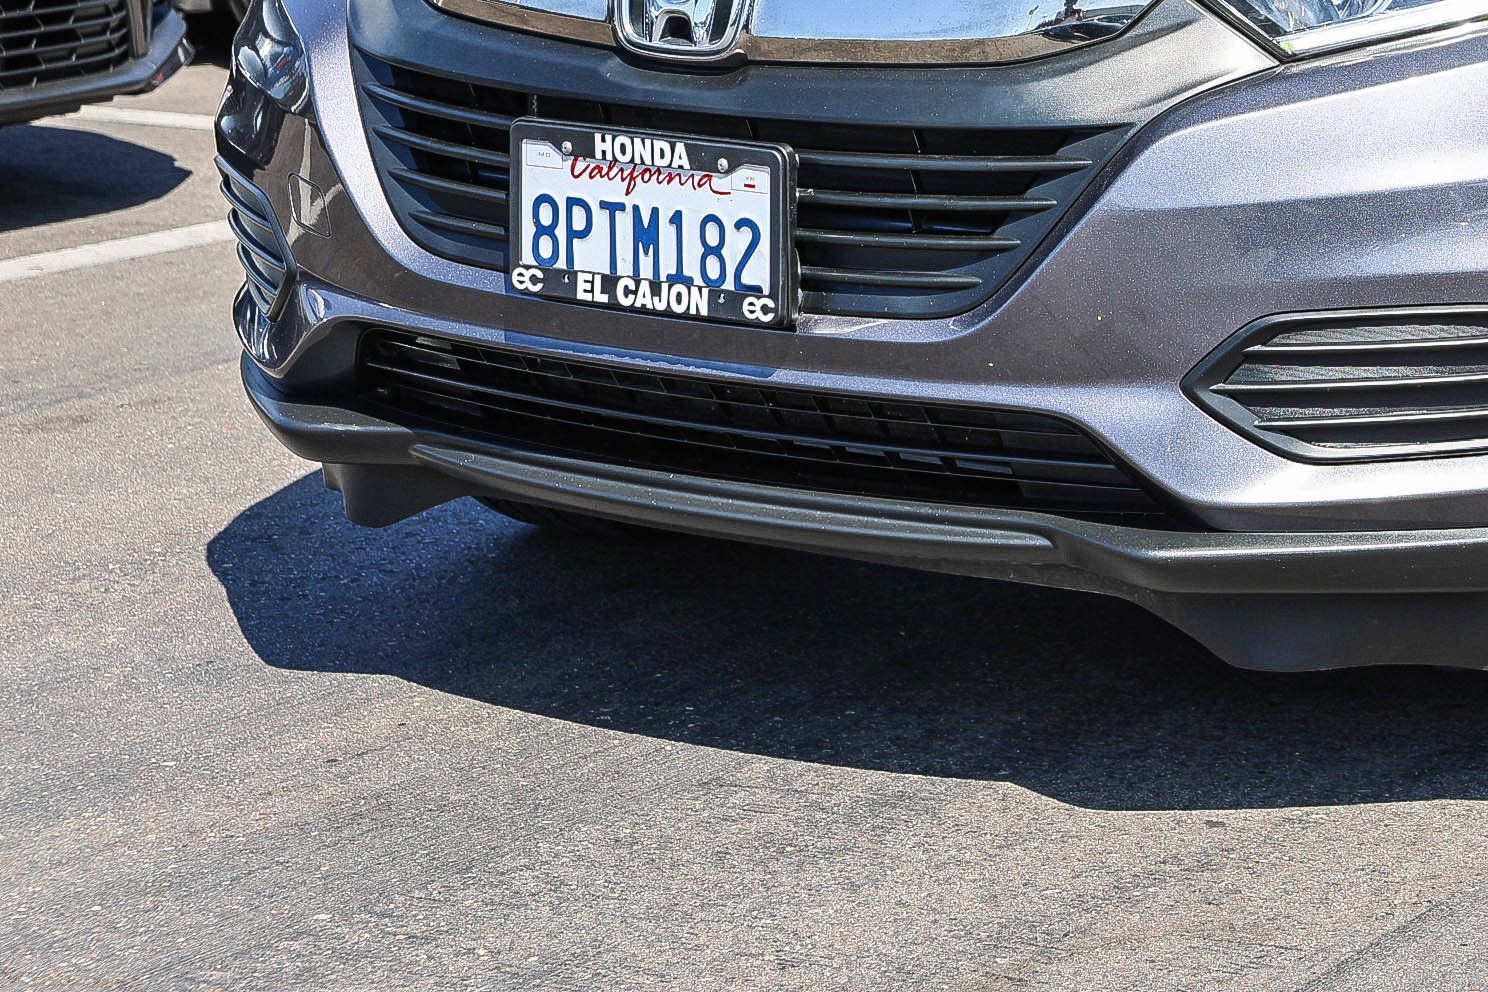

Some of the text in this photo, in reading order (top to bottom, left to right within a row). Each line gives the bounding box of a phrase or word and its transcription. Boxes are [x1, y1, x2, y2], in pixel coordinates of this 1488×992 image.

[594, 133, 690, 170] HONDA
[570, 155, 732, 196] California
[532, 193, 764, 295] 8PTM182
[576, 272, 709, 316] EL CAJON
